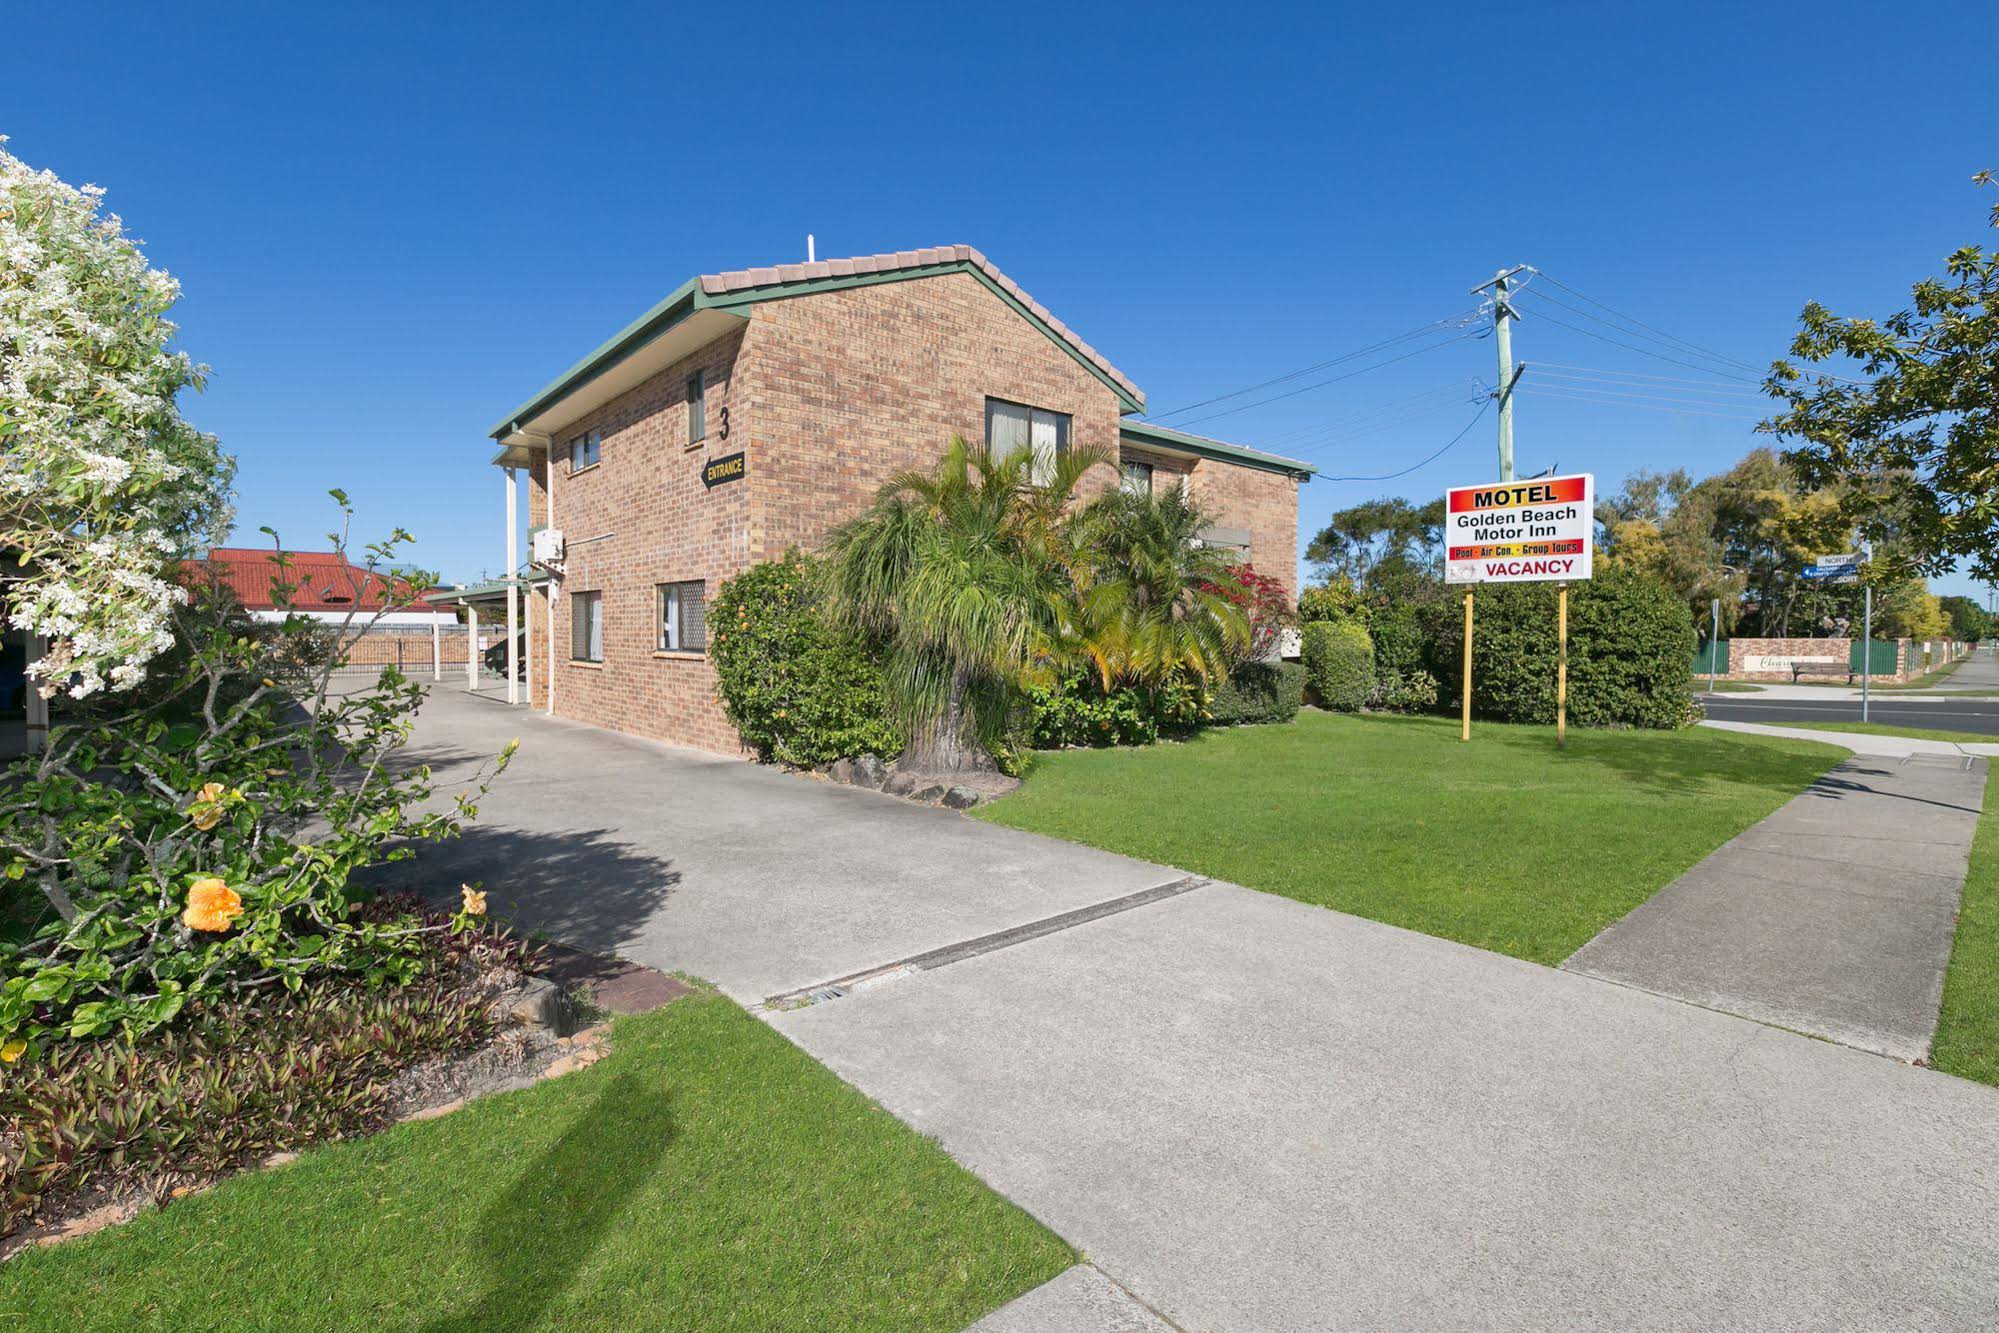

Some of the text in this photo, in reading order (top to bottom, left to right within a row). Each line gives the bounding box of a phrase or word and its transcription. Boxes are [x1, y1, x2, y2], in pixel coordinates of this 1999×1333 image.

[719, 406, 729, 440] 3
[708, 458, 742, 481] ENTRANCE
[1474, 485, 1557, 508] MOTEL
[1457, 507, 1576, 528] Golden Beach
[1474, 525, 1556, 541] Motor Inn
[1456, 549, 1472, 558] Pool
[1481, 547, 1493, 557] Air
[1522, 544, 1549, 555] Group
[1552, 543, 1577, 553] Tours
[1486, 559, 1573, 577] VACANCY
